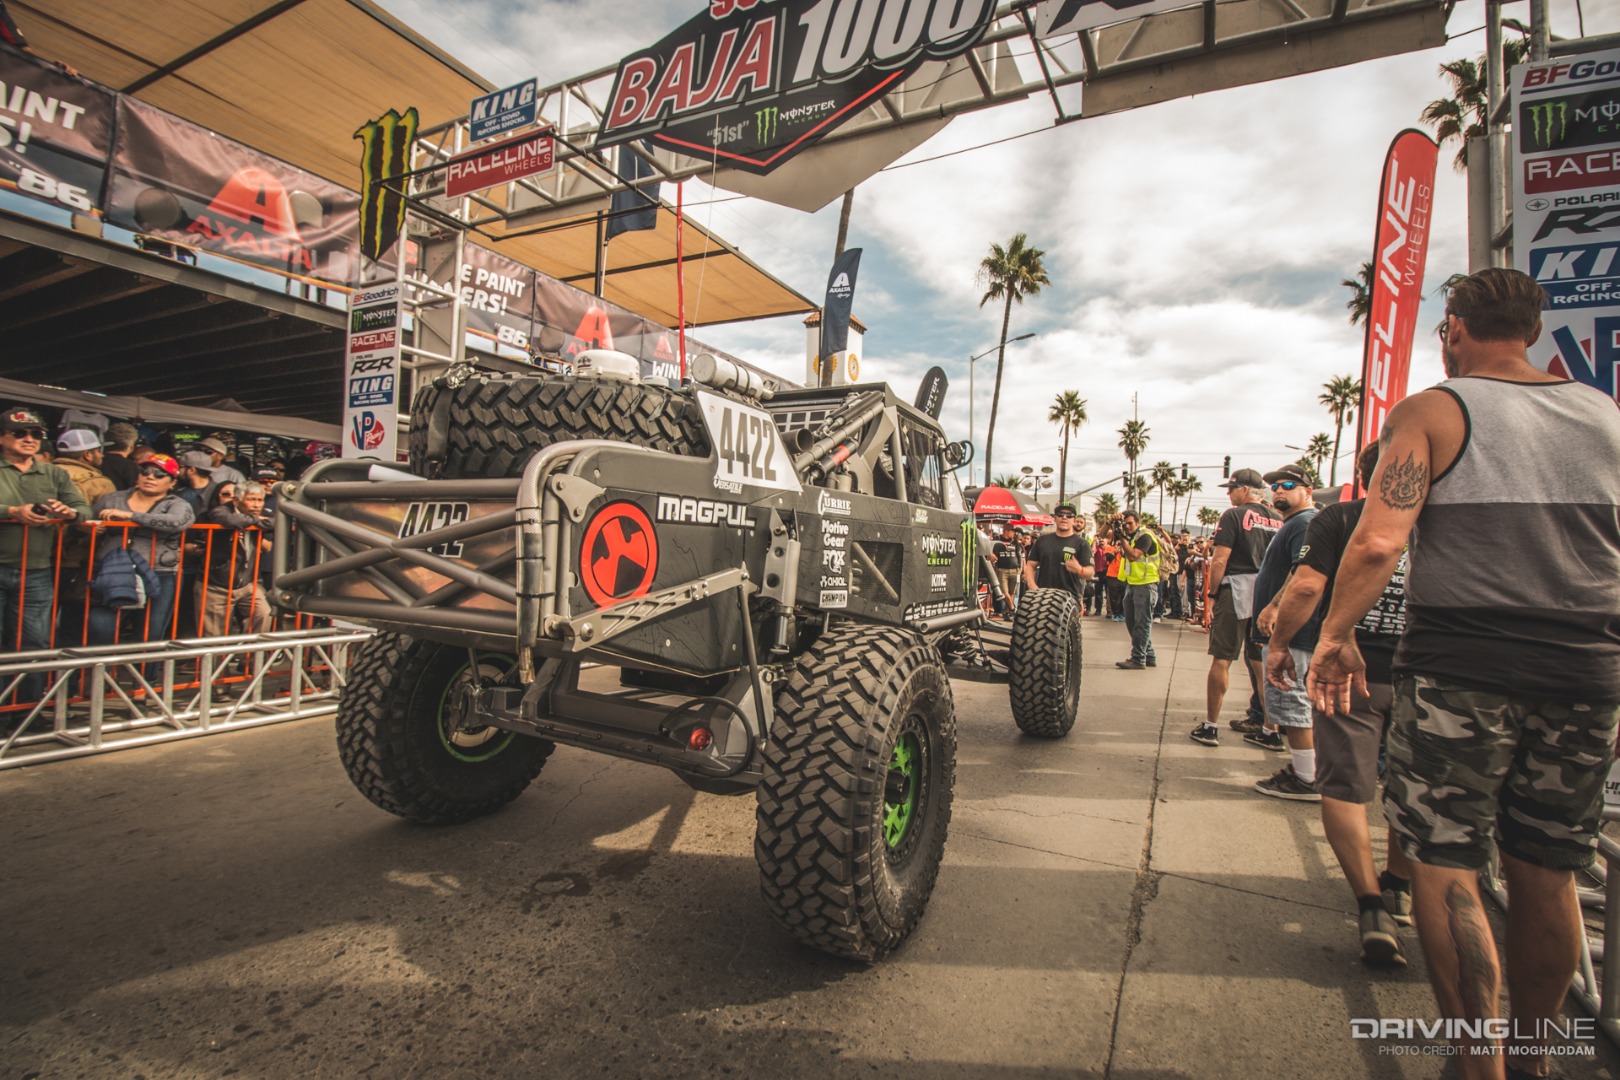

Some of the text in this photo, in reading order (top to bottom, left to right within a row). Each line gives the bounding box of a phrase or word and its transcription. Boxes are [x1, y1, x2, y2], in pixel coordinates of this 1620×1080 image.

[604, 16, 776, 133] BAJA
[472, 82, 535, 121] KING
[780, 100, 836, 121] MONSTER
[788, 113, 827, 126] ENERGY
[504, 153, 551, 175] WHEELS
[186, 215, 313, 271] AXALTA
[1403, 184, 1431, 286] WHEELS
[475, 268, 526, 297] PAINT
[354, 287, 400, 303] BFGoodrich
[362, 308, 396, 321] MONSTER
[351, 331, 395, 348] RACELINE
[351, 356, 394, 376] RZR
[351, 376, 393, 394] KING
[353, 411, 375, 450] VP
[720, 407, 777, 482] 4422
[657, 496, 755, 527] MAGPUL
[818, 489, 852, 516] CURRIE
[821, 519, 849, 535] Motive
[823, 533, 846, 548] Gear
[922, 533, 957, 554] MONSTER
[822, 549, 846, 574] FOX
[927, 558, 952, 566] ENERGY
